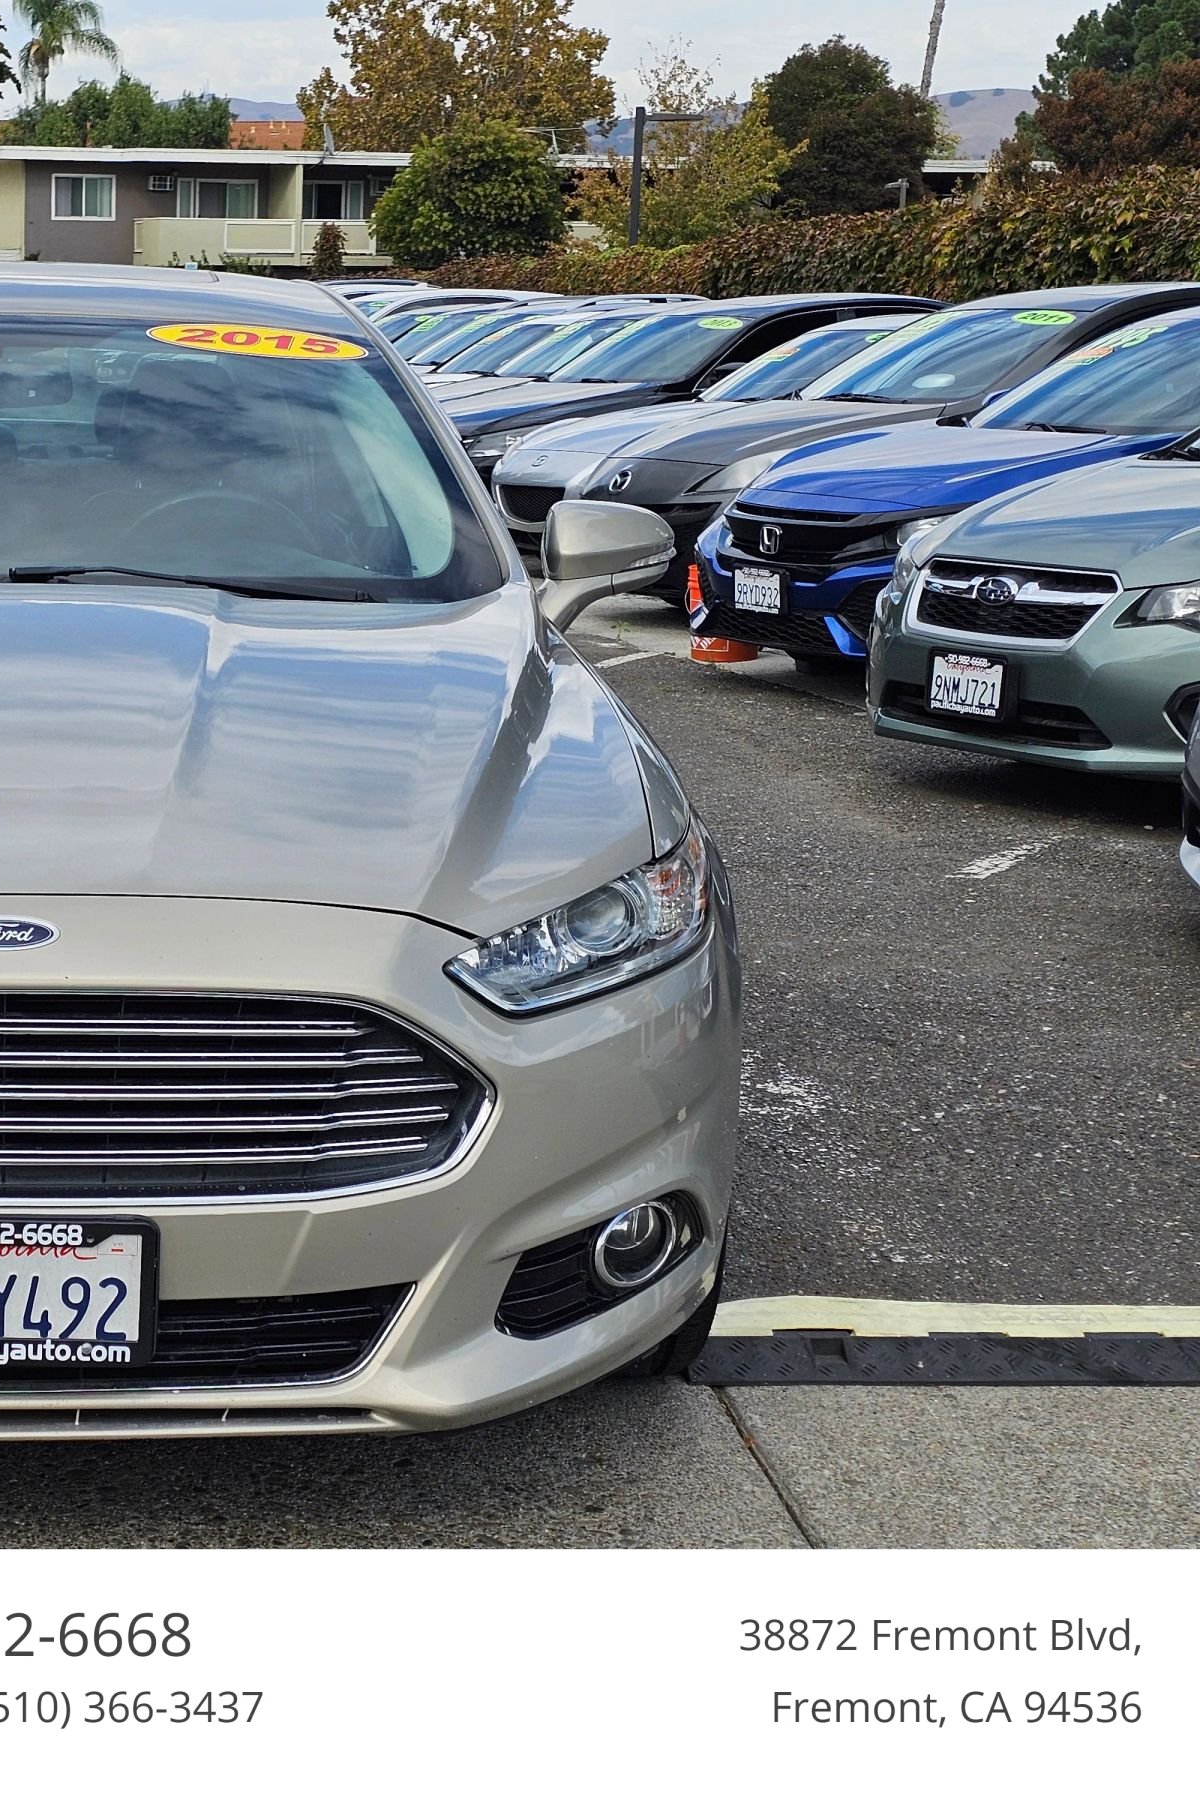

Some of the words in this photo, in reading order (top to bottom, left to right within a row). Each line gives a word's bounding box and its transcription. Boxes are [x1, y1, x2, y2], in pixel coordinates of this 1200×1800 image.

[1017, 312, 1069, 323] 2011
[176, 328, 340, 354] 2015
[737, 582, 779, 608] 9RYD932
[933, 674, 996, 708] 9NMJ721
[931, 699, 996, 717] pacificbayauto.com
